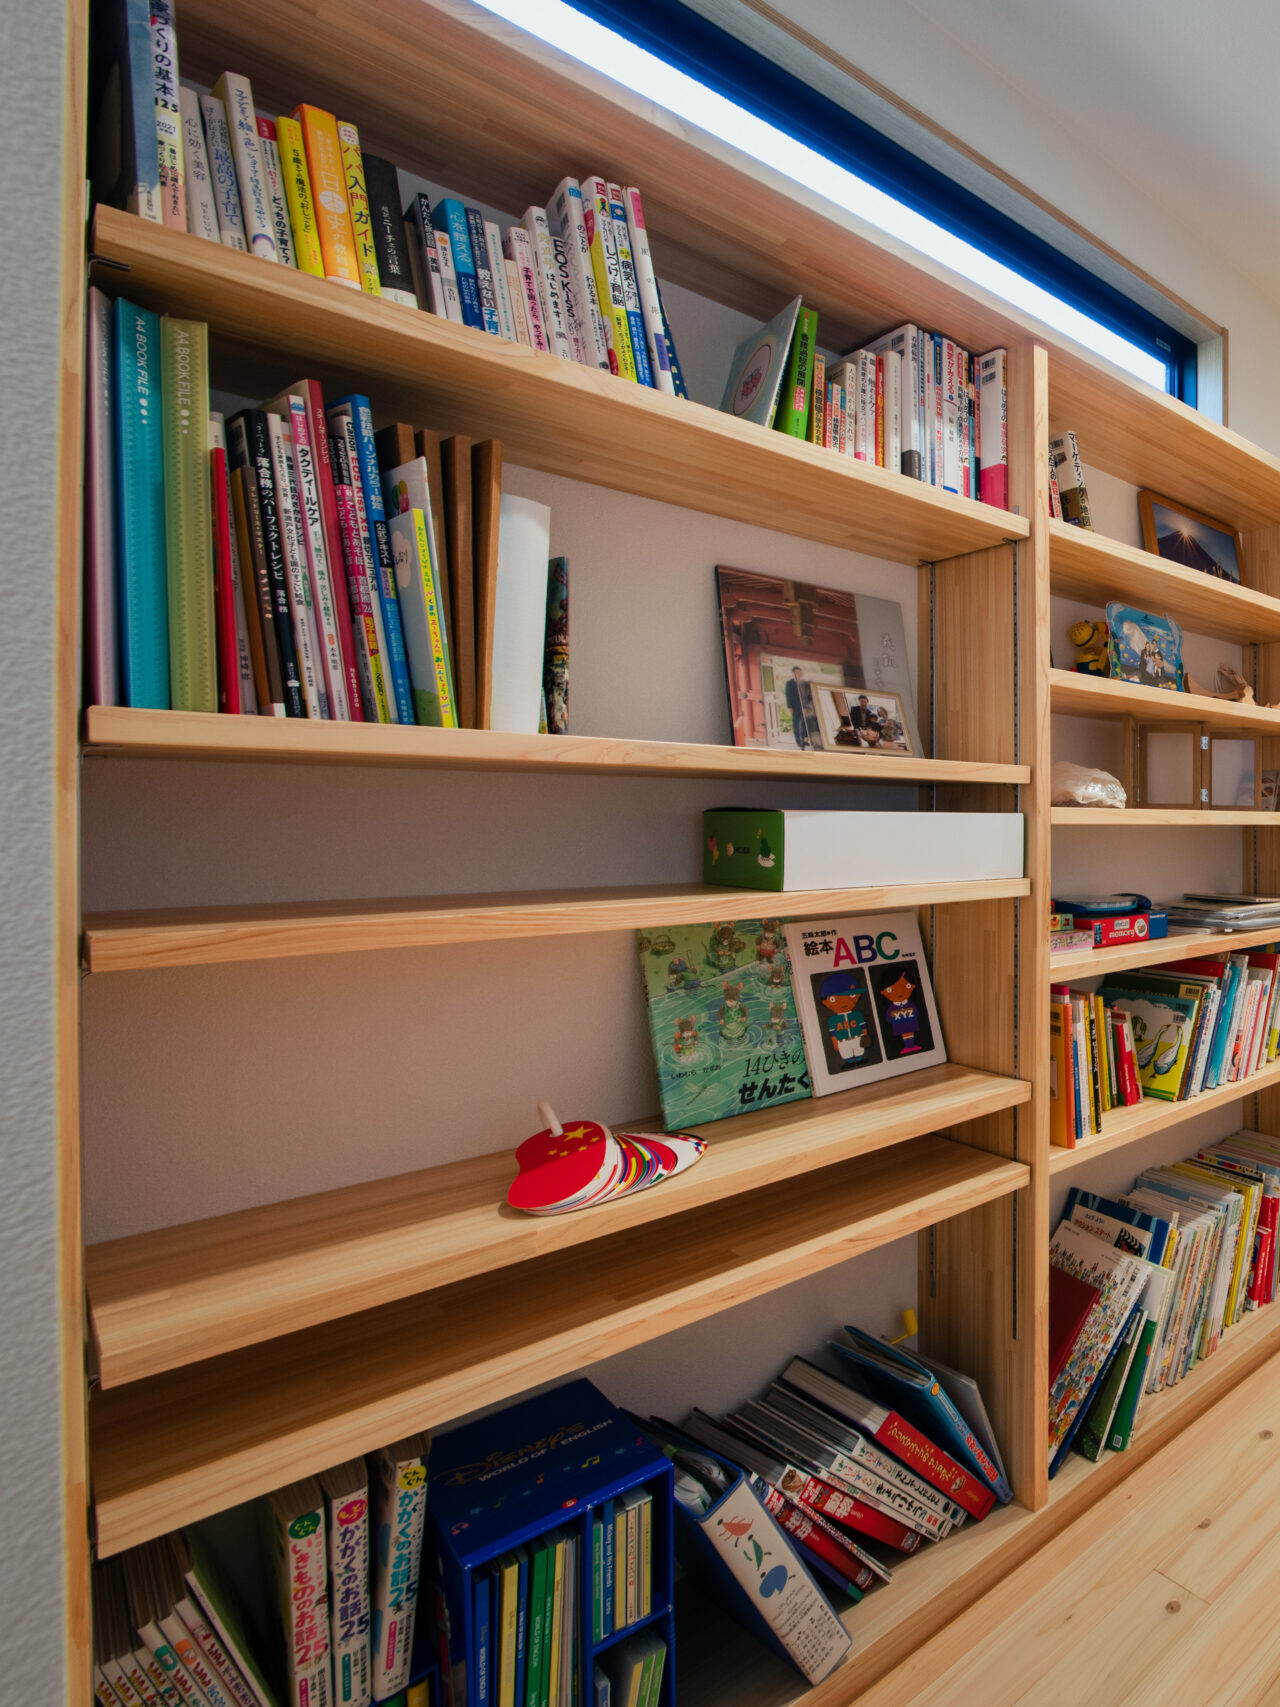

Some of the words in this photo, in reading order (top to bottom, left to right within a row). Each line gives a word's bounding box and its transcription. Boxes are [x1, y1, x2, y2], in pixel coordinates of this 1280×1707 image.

[156, 120, 177, 133] 2021
[341, 146, 375, 258] パパ入門ガイド
[552, 238, 569, 279] EOS
[477, 268, 501, 336] 教えない子育
[135, 315, 146, 333] A4
[177, 329, 189, 345] A4
[136, 333, 147, 371] BOOK
[176, 346, 190, 381] BOOK
[136, 369, 148, 395] FILE
[178, 380, 190, 405] FILE
[346, 420, 356, 452] Canon
[298, 447, 320, 527] タクティールケア
[350, 456, 362, 483] EOS
[256, 456, 284, 580] 落合務のパーフェクトレシピ
[353, 486, 366, 515] Kiss
[803, 939, 834, 957] 絵本
[833, 931, 901, 968] ABC
[1108, 928, 1136, 939] memory
[836, 1020, 857, 1032] ABC
[893, 1009, 915, 1021] XYZ
[742, 1049, 808, 1079] 14ひきの
[738, 1070, 812, 1105] せんたく
[478, 1454, 529, 1482] WORLD
[530, 1446, 549, 1460] OF
[560, 1418, 614, 1446] ENGLISH
[388, 1489, 421, 1608] かがくのお話25
[338, 1525, 371, 1642] かがくのお話25
[290, 1537, 330, 1667] いきもののお話25
